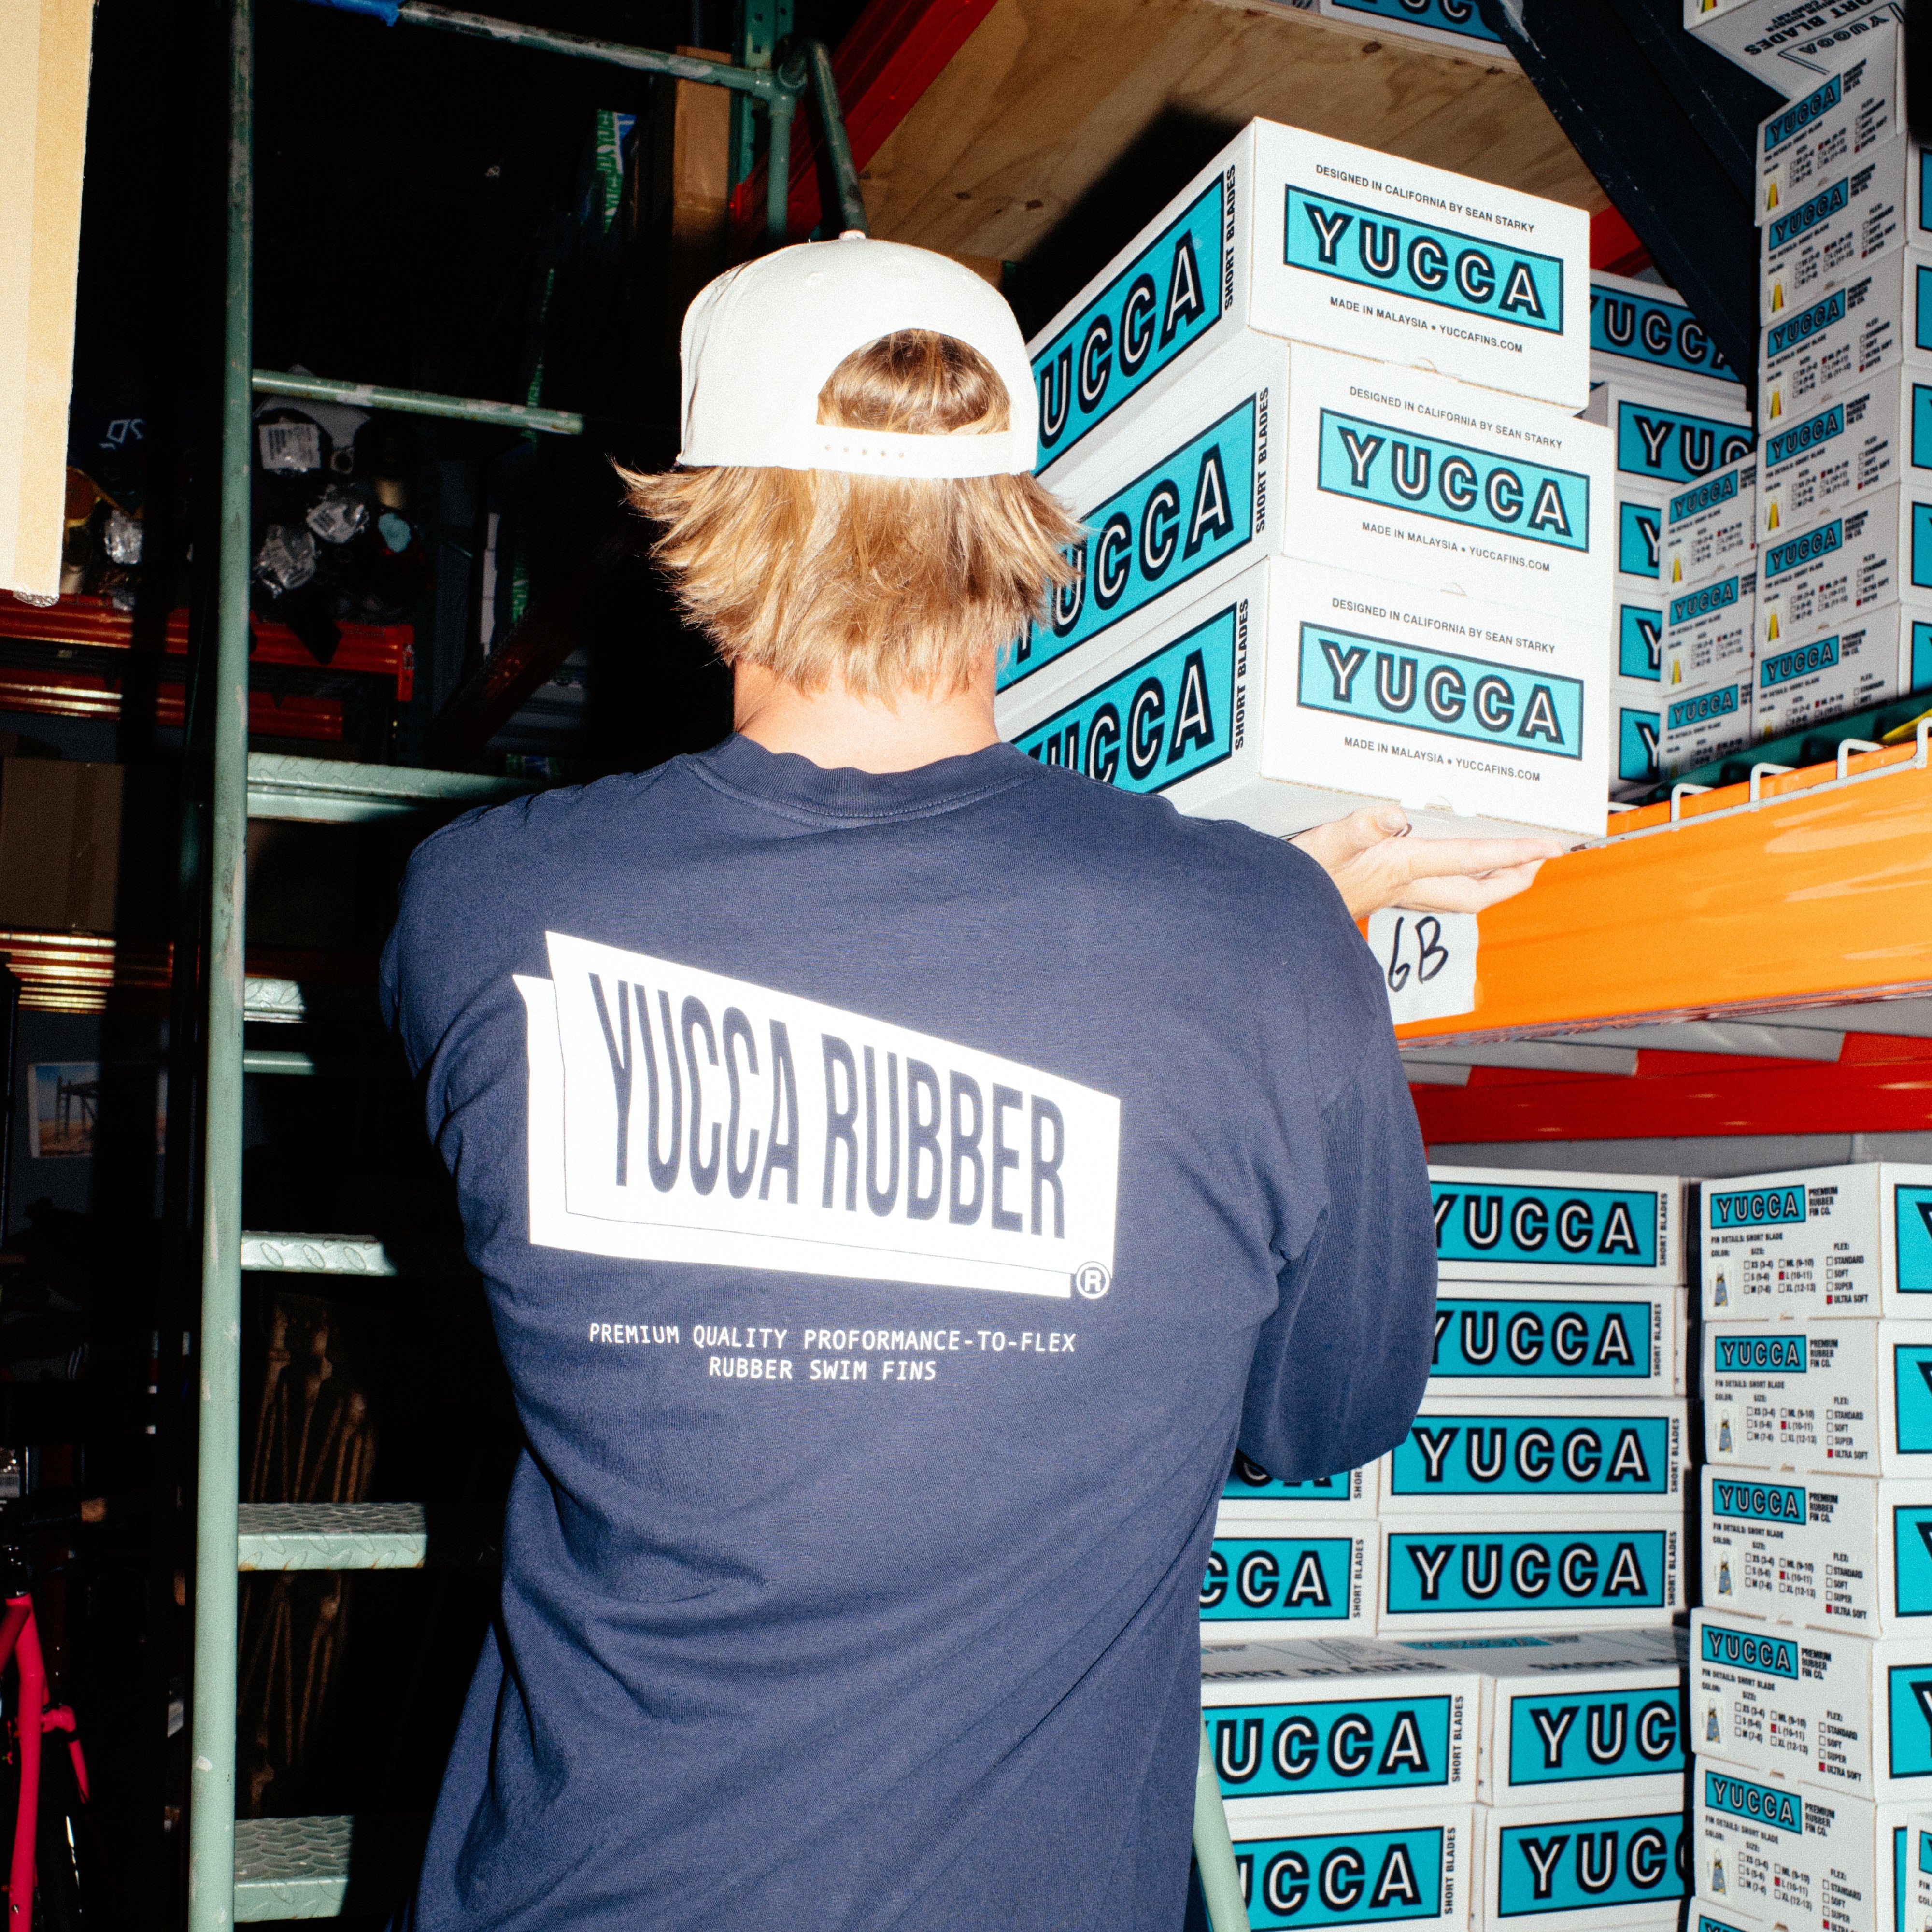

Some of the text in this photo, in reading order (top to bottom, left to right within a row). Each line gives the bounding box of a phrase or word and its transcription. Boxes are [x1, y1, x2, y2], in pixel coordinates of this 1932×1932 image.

[1744, 15, 1827, 56] BLADES
[1798, 15, 1889, 55] YUCCA
[1770, 85, 1836, 142] YUCCA
[1316, 164, 1534, 233] DESIGNED IN CALIFORNIA BY SEAN STARKY
[1775, 186, 1843, 242] YUCCA
[1224, 164, 1236, 311] SHORT BLADES
[1303, 201, 1546, 319] YUCCA
[1034, 228, 1206, 450] UCCA
[1330, 296, 1523, 353] MADE IN MALAYSIA YUCCAFINS.COM
[1591, 296, 1739, 374] UCC
[1773, 299, 1840, 350] YUCCA
[1350, 386, 1562, 449] DESIGNED IN CALIFORNIA BY SEAN STARKY
[1772, 408, 1839, 455] YUCCA
[1256, 387, 1269, 534] SHORT BLADES
[1337, 426, 1572, 537] YUCCA
[1675, 480, 1734, 517] YUCCA
[1362, 521, 1550, 572] MADE IN MALAYSIA YUCCAFINS.COM
[1772, 527, 1837, 570] YUCCA
[1675, 584, 1734, 618] YUCCA
[1332, 597, 1555, 654] DESIGNED IN CALIFORNIA BY SEAN STARKY
[1235, 598, 1249, 750] SHORT BLADES
[1766, 643, 1834, 682] YUCCA
[1318, 639, 1565, 745] YUCCA
[1673, 694, 1734, 724] YUCCA
[1028, 647, 1215, 785] UCCA
[1344, 736, 1540, 782] MADE IN MALAYSIA YUCCAFINS.COM
[1388, 916, 1449, 993] 6B
[588, 973, 1065, 1240] YUCCA RUBBER
[1717, 1192, 1799, 1222] YUCCA
[1809, 1187, 1838, 1197] PREMIUM
[1810, 1197, 1834, 1206] RUBBER
[1659, 1193, 1668, 1266] SHORT BLADES
[1810, 1207, 1831, 1216] FIN CO.
[1722, 1235, 1745, 1243] DETAILS:
[1747, 1234, 1764, 1242] SHORT
[1765, 1233, 1783, 1241] BLADE
[1834, 1256, 1864, 1265] STANDARD
[1834, 1269, 1848, 1278] SOFT
[1834, 1282, 1853, 1291] SUPER
[1834, 1294, 1868, 1304] ULTRA SOFT
[589, 1322, 1076, 1352] PREMIUM QUALITY PROFORMANCE-TO-FLEX
[1653, 1303, 1662, 1338] BLADES
[1721, 1341, 1800, 1367] YUCCA
[1810, 1339, 1838, 1348] PREMIUM
[1810, 1349, 1833, 1358] RUBBER
[709, 1356, 936, 1381] RUBBER SWIM FINS
[1810, 1359, 1831, 1368] FIN CO.
[1834, 1410, 1863, 1420] STANDARD
[1834, 1423, 1848, 1433] SOFT
[1410, 1427, 1650, 1482] YUCCA
[1671, 1417, 1680, 1455] BLADES
[1834, 1450, 1868, 1460] ULTRA SOFT
[1354, 1469, 1362, 1499] SHOR
[1718, 1484, 1799, 1519] YUCCA
[1809, 1492, 1838, 1504] PREMIUM
[1810, 1503, 1833, 1513] RUBBER
[1810, 1513, 1831, 1523] FIN CO.
[1668, 1530, 1676, 1568] BLADES
[1353, 1539, 1364, 1618] SHORT BLADES
[1405, 1543, 1648, 1600] YUCCA
[1833, 1566, 1863, 1579] STANDARD
[1708, 1631, 1791, 1673] YUCCA
[1802, 1648, 1832, 1661] PREMIUM
[1802, 1658, 1827, 1671] RUBBER
[1802, 1668, 1824, 1680] FIN CO.
[1204, 1710, 1430, 1784] UCCA
[1451, 1696, 1463, 1782] SHORT BLADES
[1827, 1725, 1857, 1740] STANDARD
[1711, 1778, 1795, 1826] YUCCA
[1805, 1802, 1835, 1819] PREMIUM
[1805, 1813, 1831, 1828] RUBBER
[1805, 1823, 1827, 1836] FIN CO.
[1444, 1827, 1456, 1915] SHORT BLADES
[1919, 1879, 1930, 1890] FIN
[1831, 1883, 1861, 1900] STANDARD
